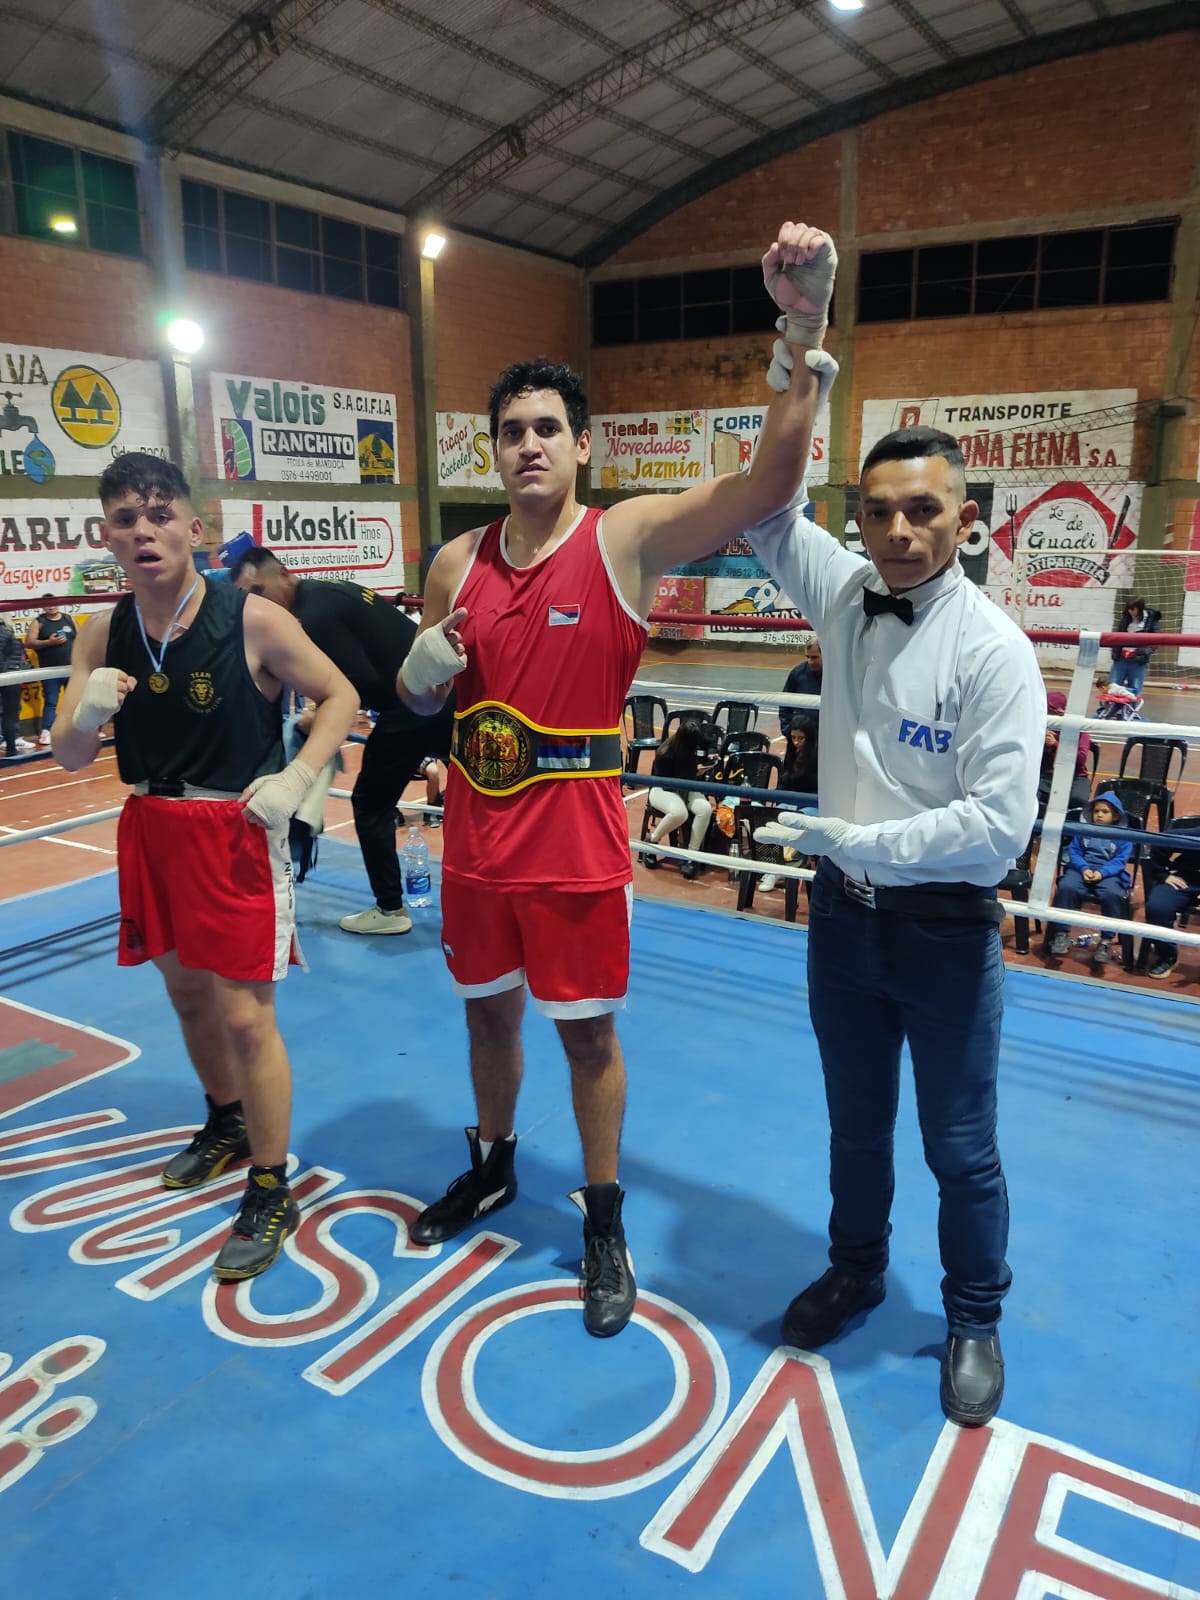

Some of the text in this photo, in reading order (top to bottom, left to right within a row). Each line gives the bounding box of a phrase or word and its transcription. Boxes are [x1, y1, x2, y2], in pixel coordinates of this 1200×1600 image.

[0, 353, 49, 385] VA
[226, 379, 326, 425] Valois
[945, 402, 1072, 423] TRANSPORTE
[602, 417, 659, 438] Tienda
[714, 414, 763, 431] CORR
[263, 430, 354, 456] RANCHITO
[439, 426, 468, 455] Tragos
[473, 431, 491, 475] S
[606, 437, 692, 459] Novedades
[957, 428, 1004, 468] OÑA
[1010, 431, 1081, 467] ELENA
[0, 450, 26, 476] LE
[0, 515, 107, 552] ARLO
[361, 525, 381, 541] Hnos
[1066, 514, 1083, 531] de
[1027, 528, 1097, 558] Guadi
[301, 552, 310, 566] de
[898, 718, 953, 754] FAB
